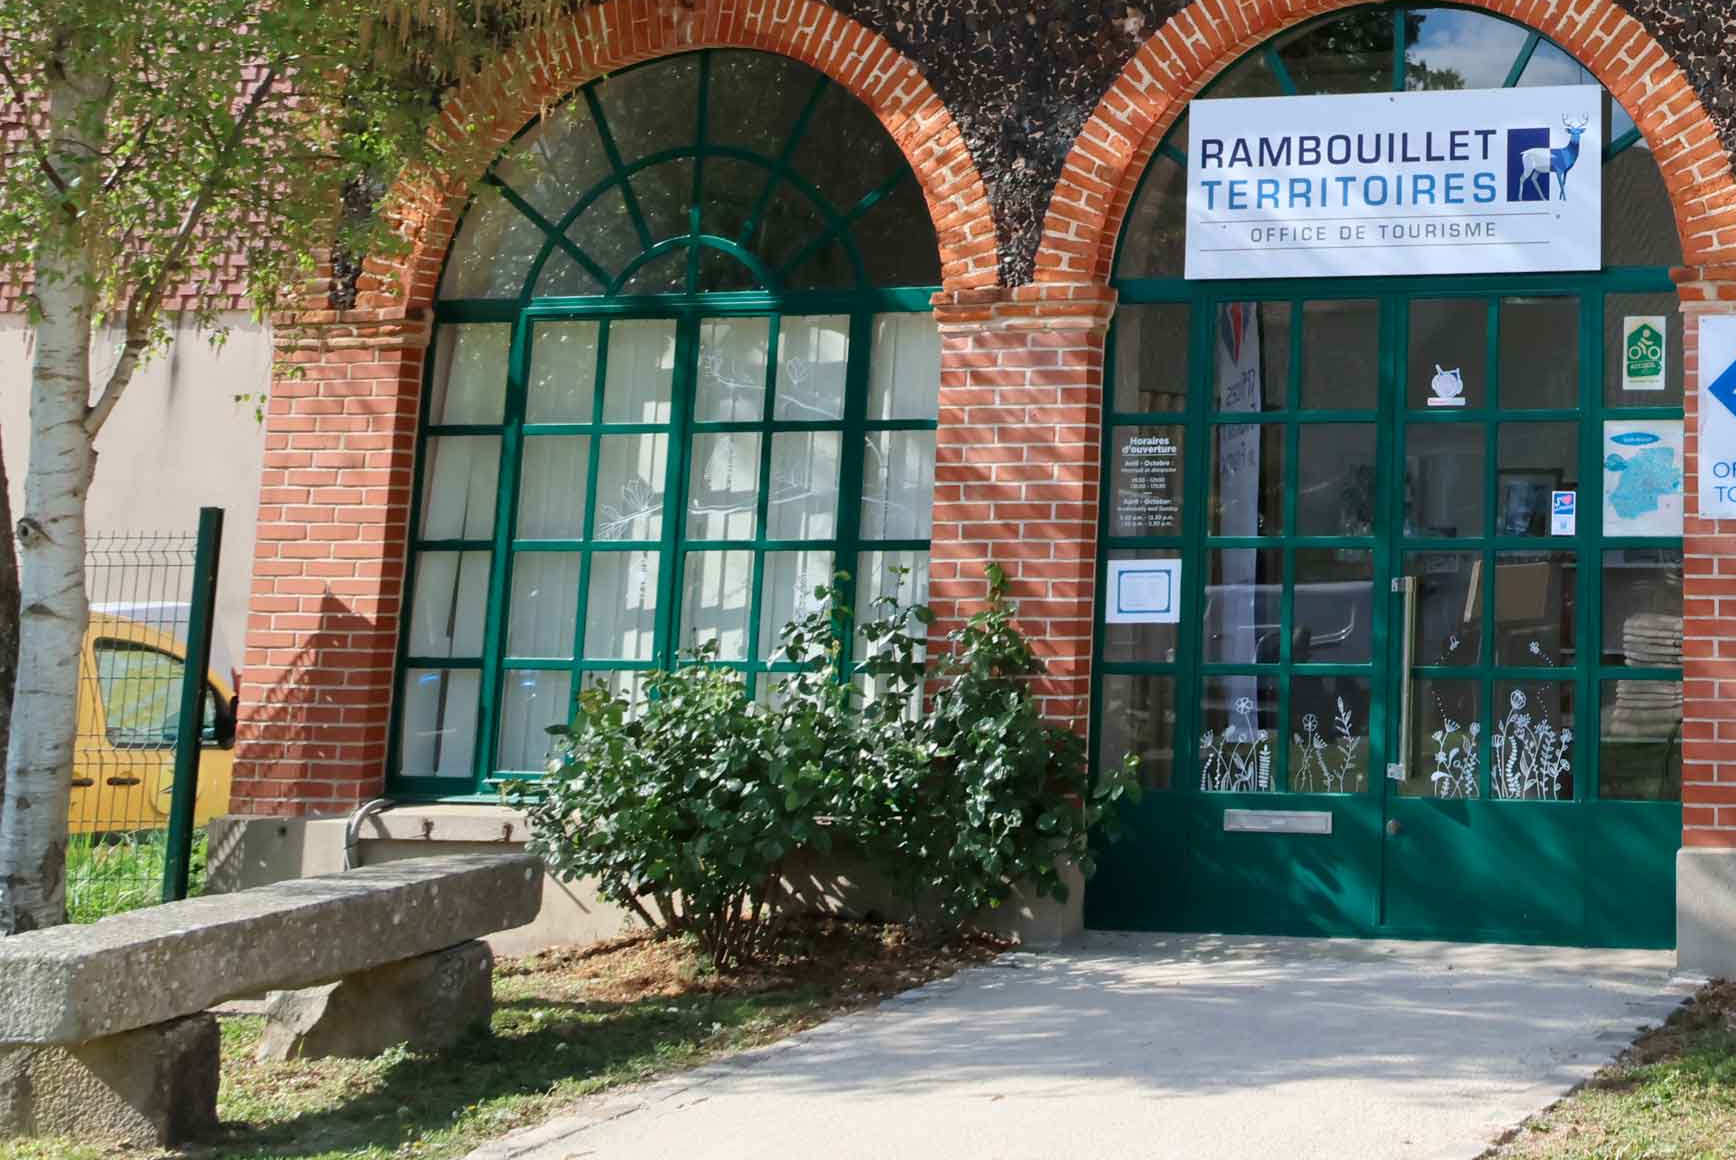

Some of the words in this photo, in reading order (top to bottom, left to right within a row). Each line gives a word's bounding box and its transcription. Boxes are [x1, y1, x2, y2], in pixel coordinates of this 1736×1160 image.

[1201, 129, 1497, 169] RAMBOUILLET
[1200, 172, 1497, 210] TERRITOIRES
[1250, 226, 1327, 242] OFFICE
[1339, 225, 1365, 241] DE
[1378, 222, 1497, 240] TOURISME
[1121, 445, 1177, 454] d'ouverture
[1129, 436, 1170, 445] Horaires
